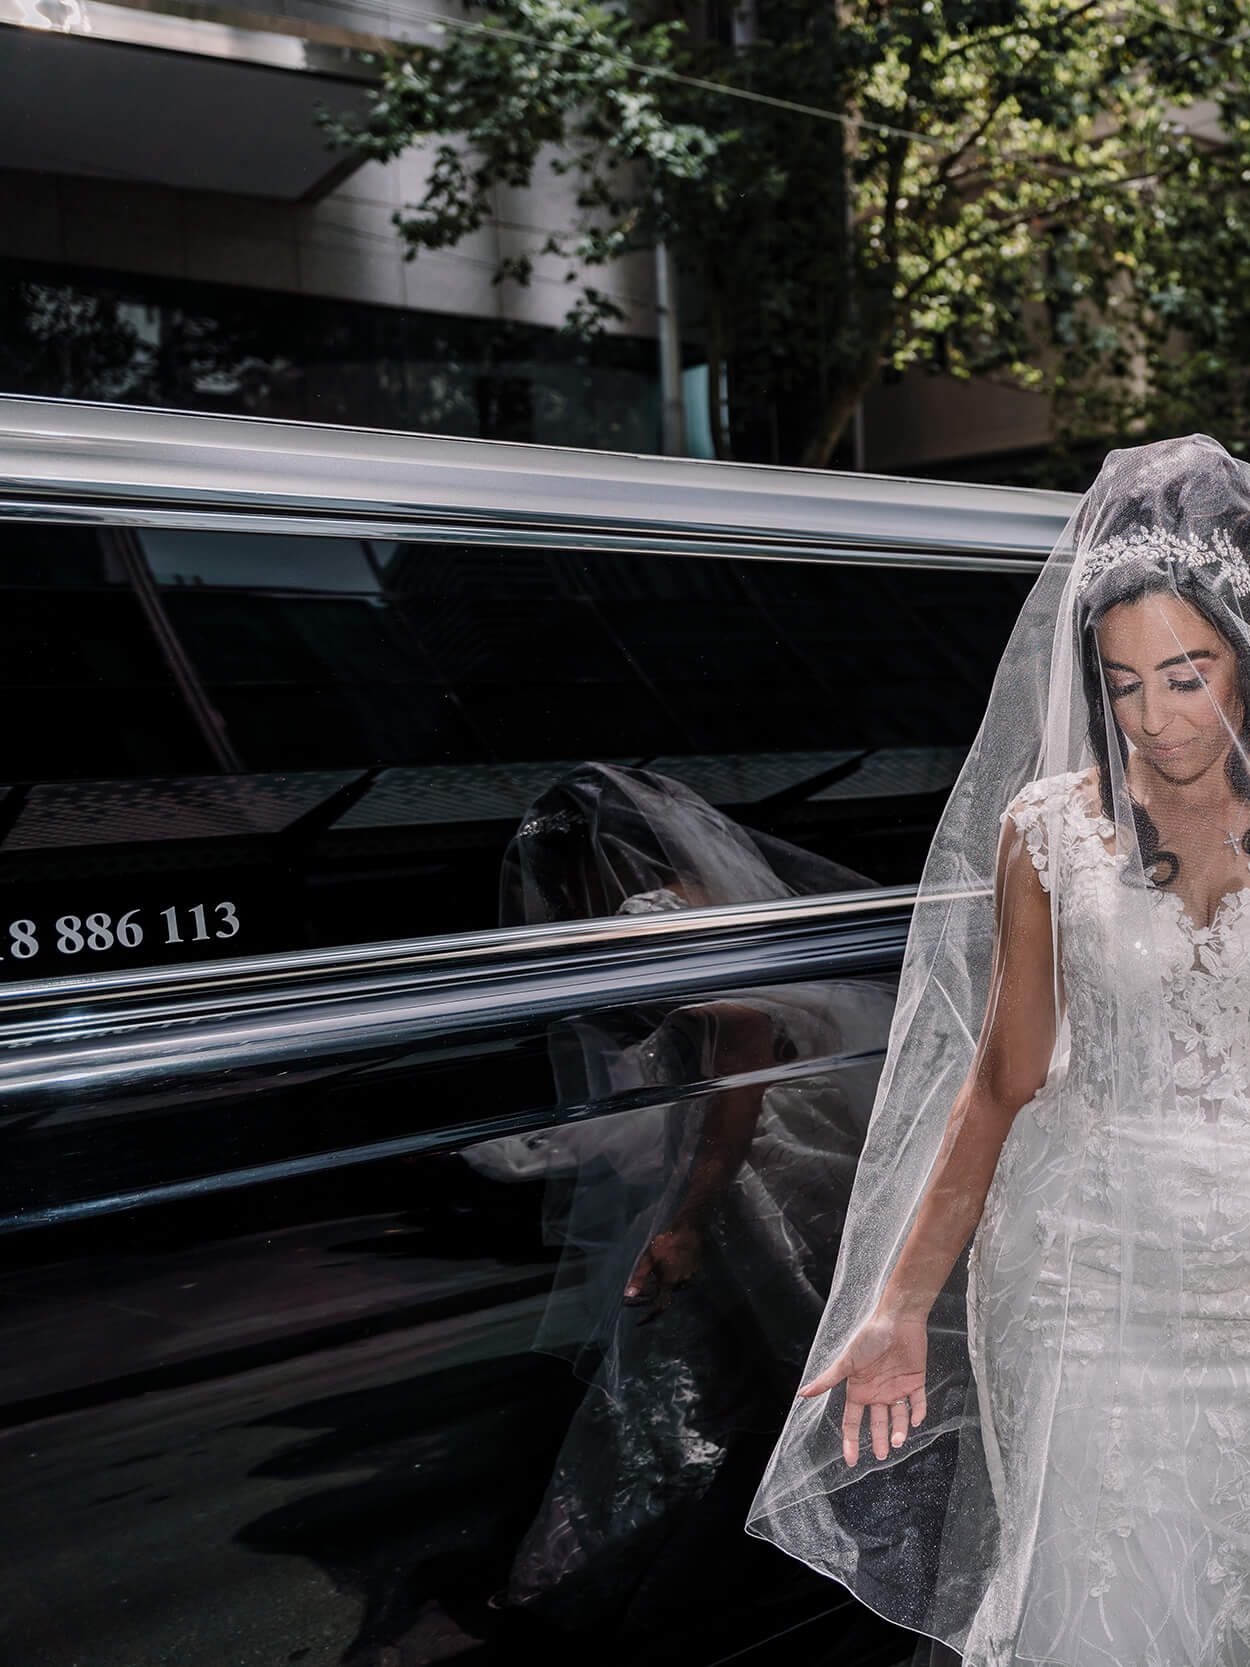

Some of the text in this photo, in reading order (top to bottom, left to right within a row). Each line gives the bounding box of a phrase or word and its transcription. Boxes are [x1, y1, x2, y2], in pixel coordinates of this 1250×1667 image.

[0, 901, 240, 960] 8 886 113
